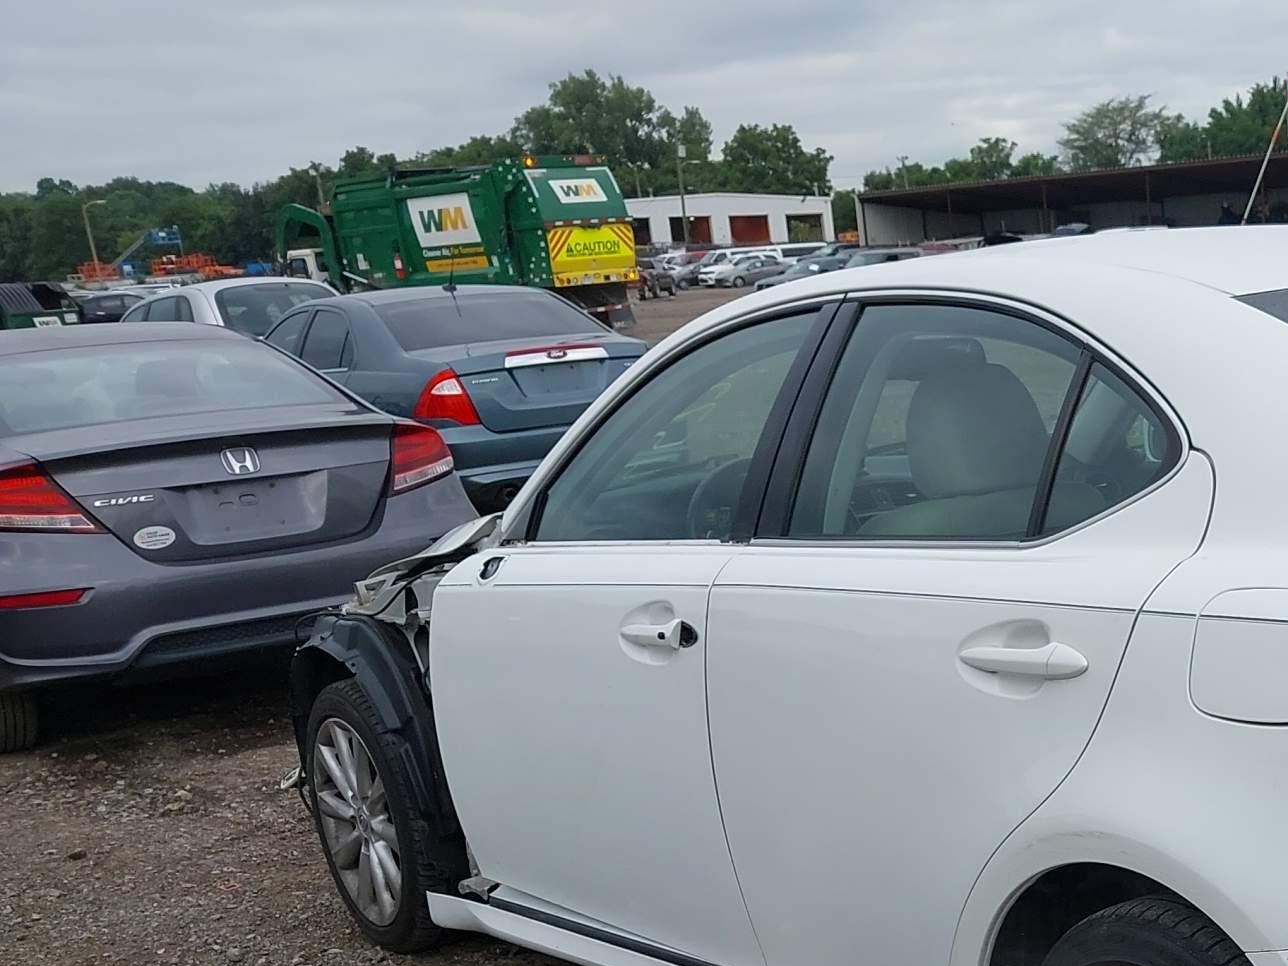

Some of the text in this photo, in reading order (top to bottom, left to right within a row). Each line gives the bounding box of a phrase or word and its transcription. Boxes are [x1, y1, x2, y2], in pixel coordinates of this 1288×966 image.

[559, 183, 598, 197] WM
[418, 206, 470, 234] WM
[574, 240, 620, 253] CAUTION
[93, 494, 155, 508] CIVIC
